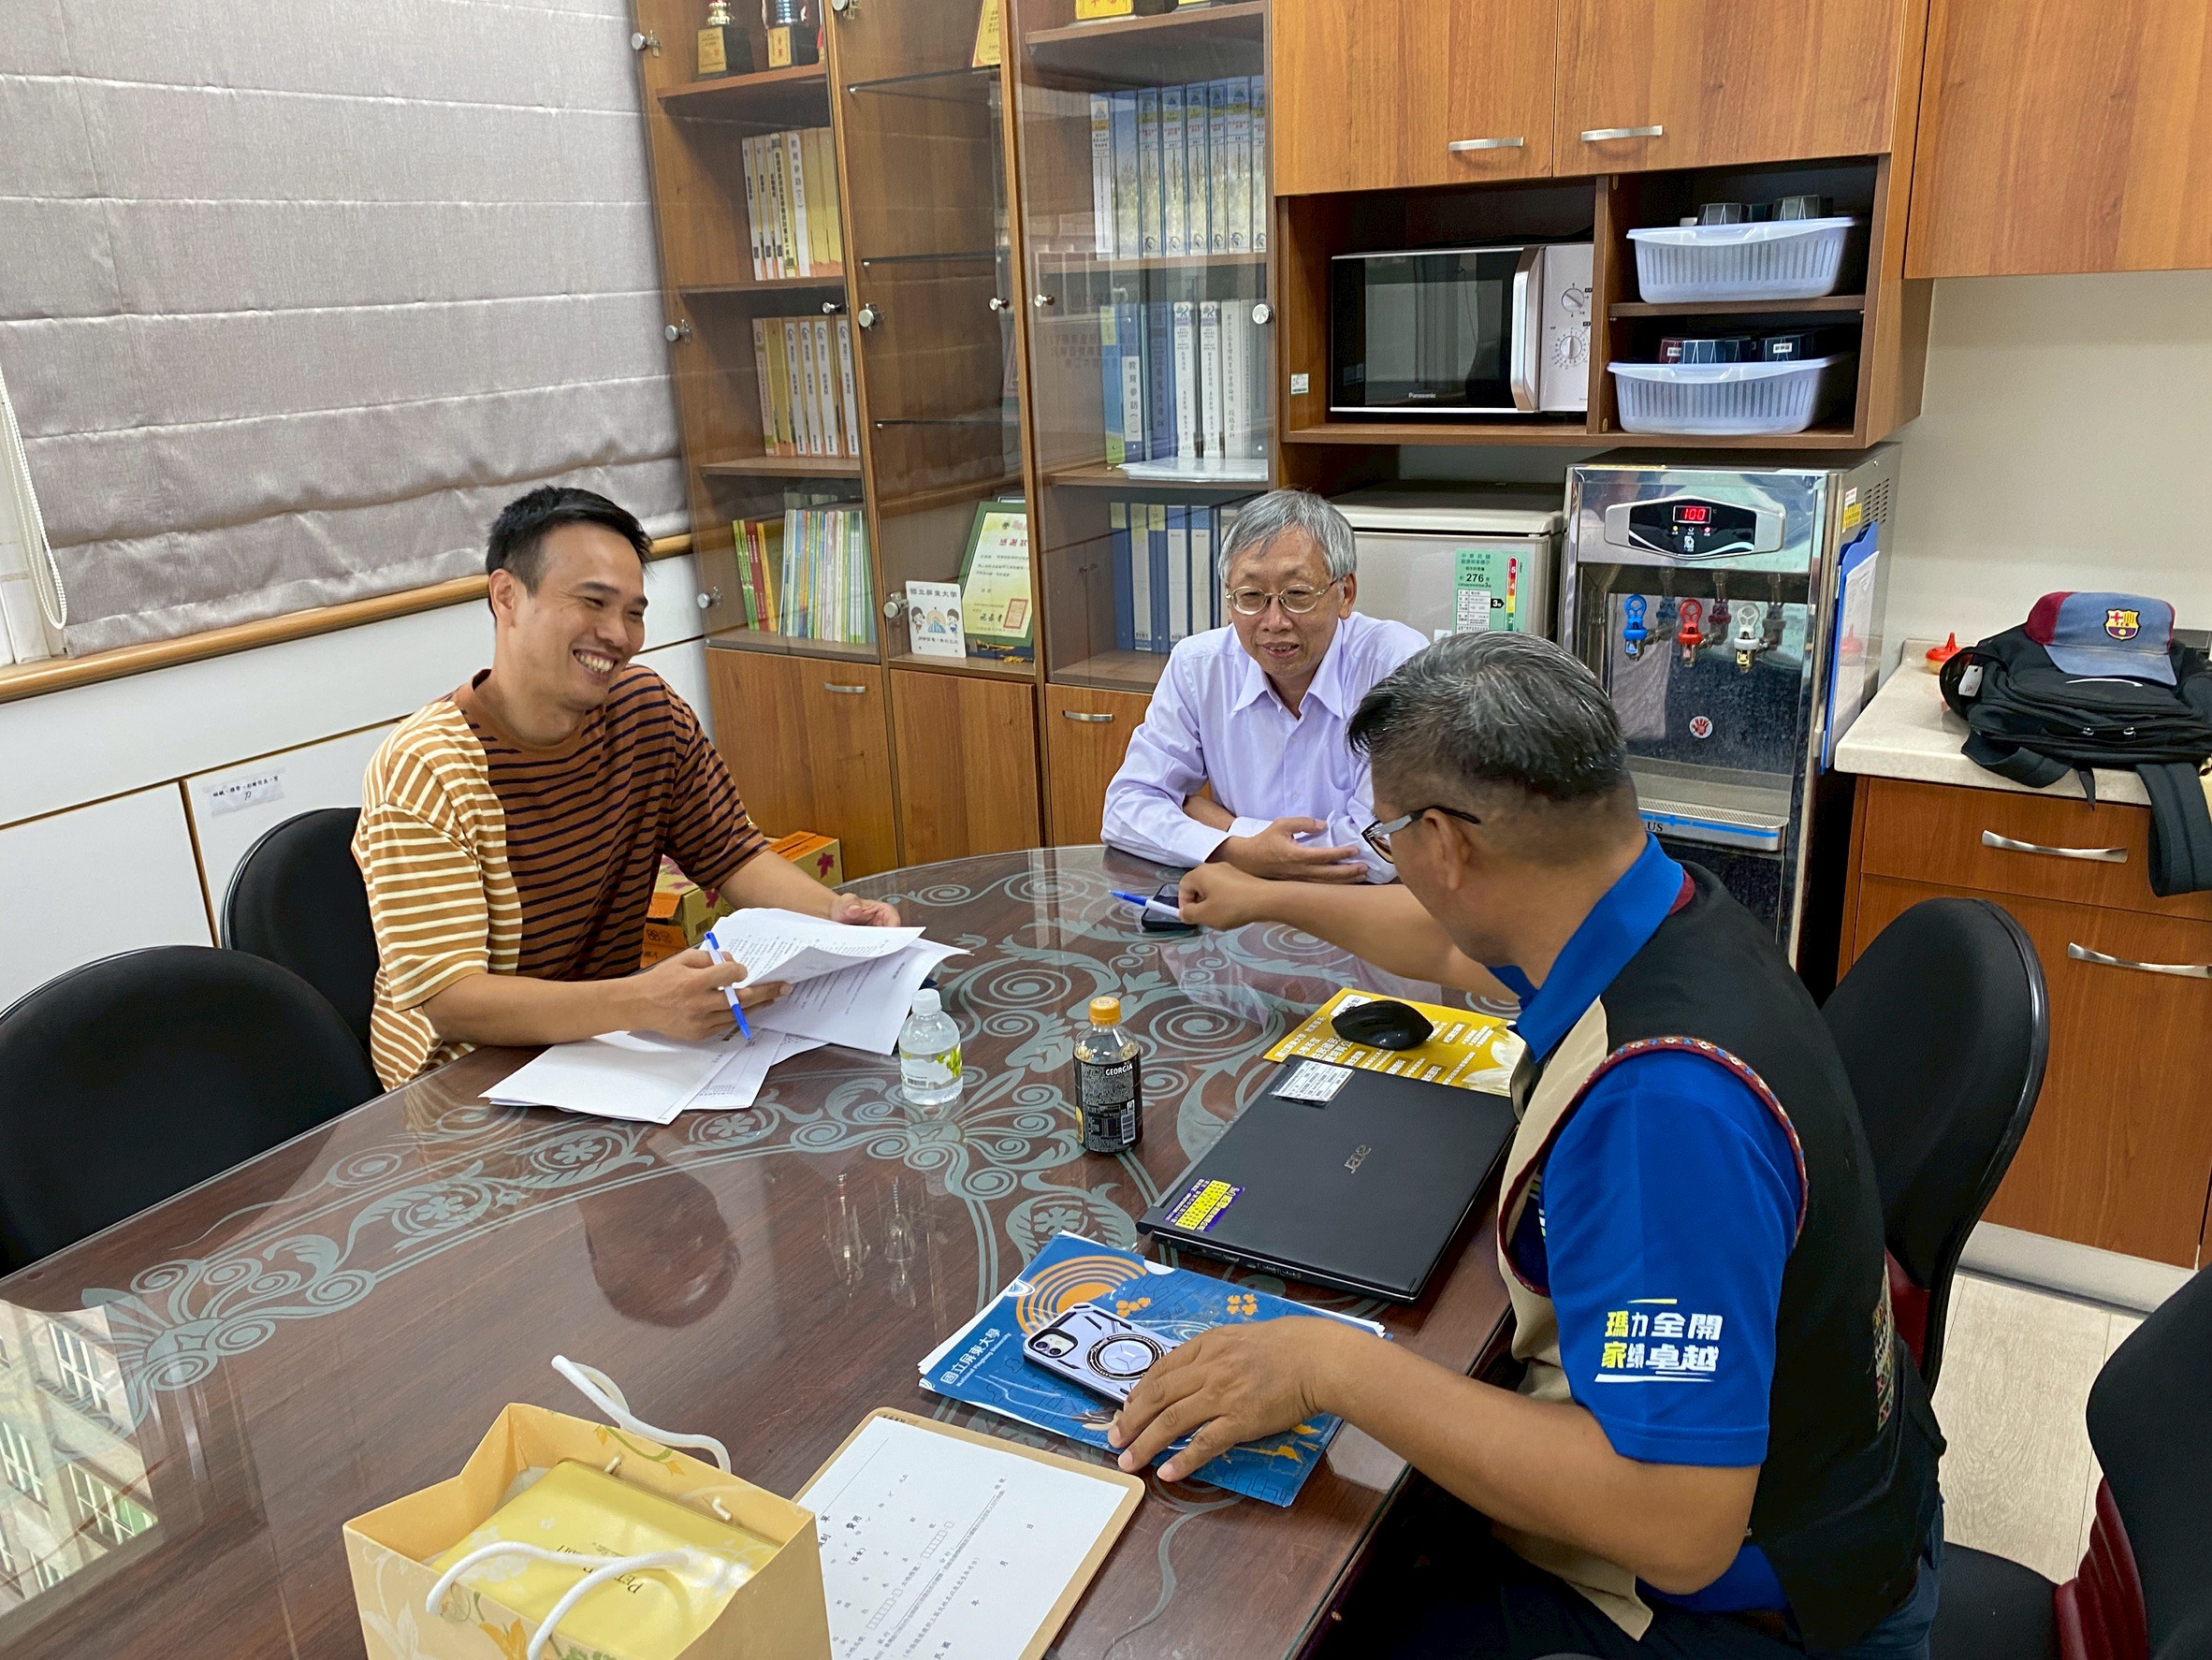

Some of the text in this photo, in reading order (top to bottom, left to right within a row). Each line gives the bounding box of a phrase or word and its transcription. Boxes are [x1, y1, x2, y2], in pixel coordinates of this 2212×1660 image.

[1682, 507, 1707, 521] 100
[1466, 574, 1484, 582] 276
[1644, 821, 1664, 832] US
[1105, 1063, 1133, 1076] GEORGIA
[1344, 1143, 1372, 1174] acer
[1604, 1310, 1724, 1341] 瑪力全開
[939, 1328, 1001, 1385] 國立屏東大學
[955, 1332, 1012, 1387] National Pingtung University
[1600, 1341, 1720, 1373] 家績卓越
